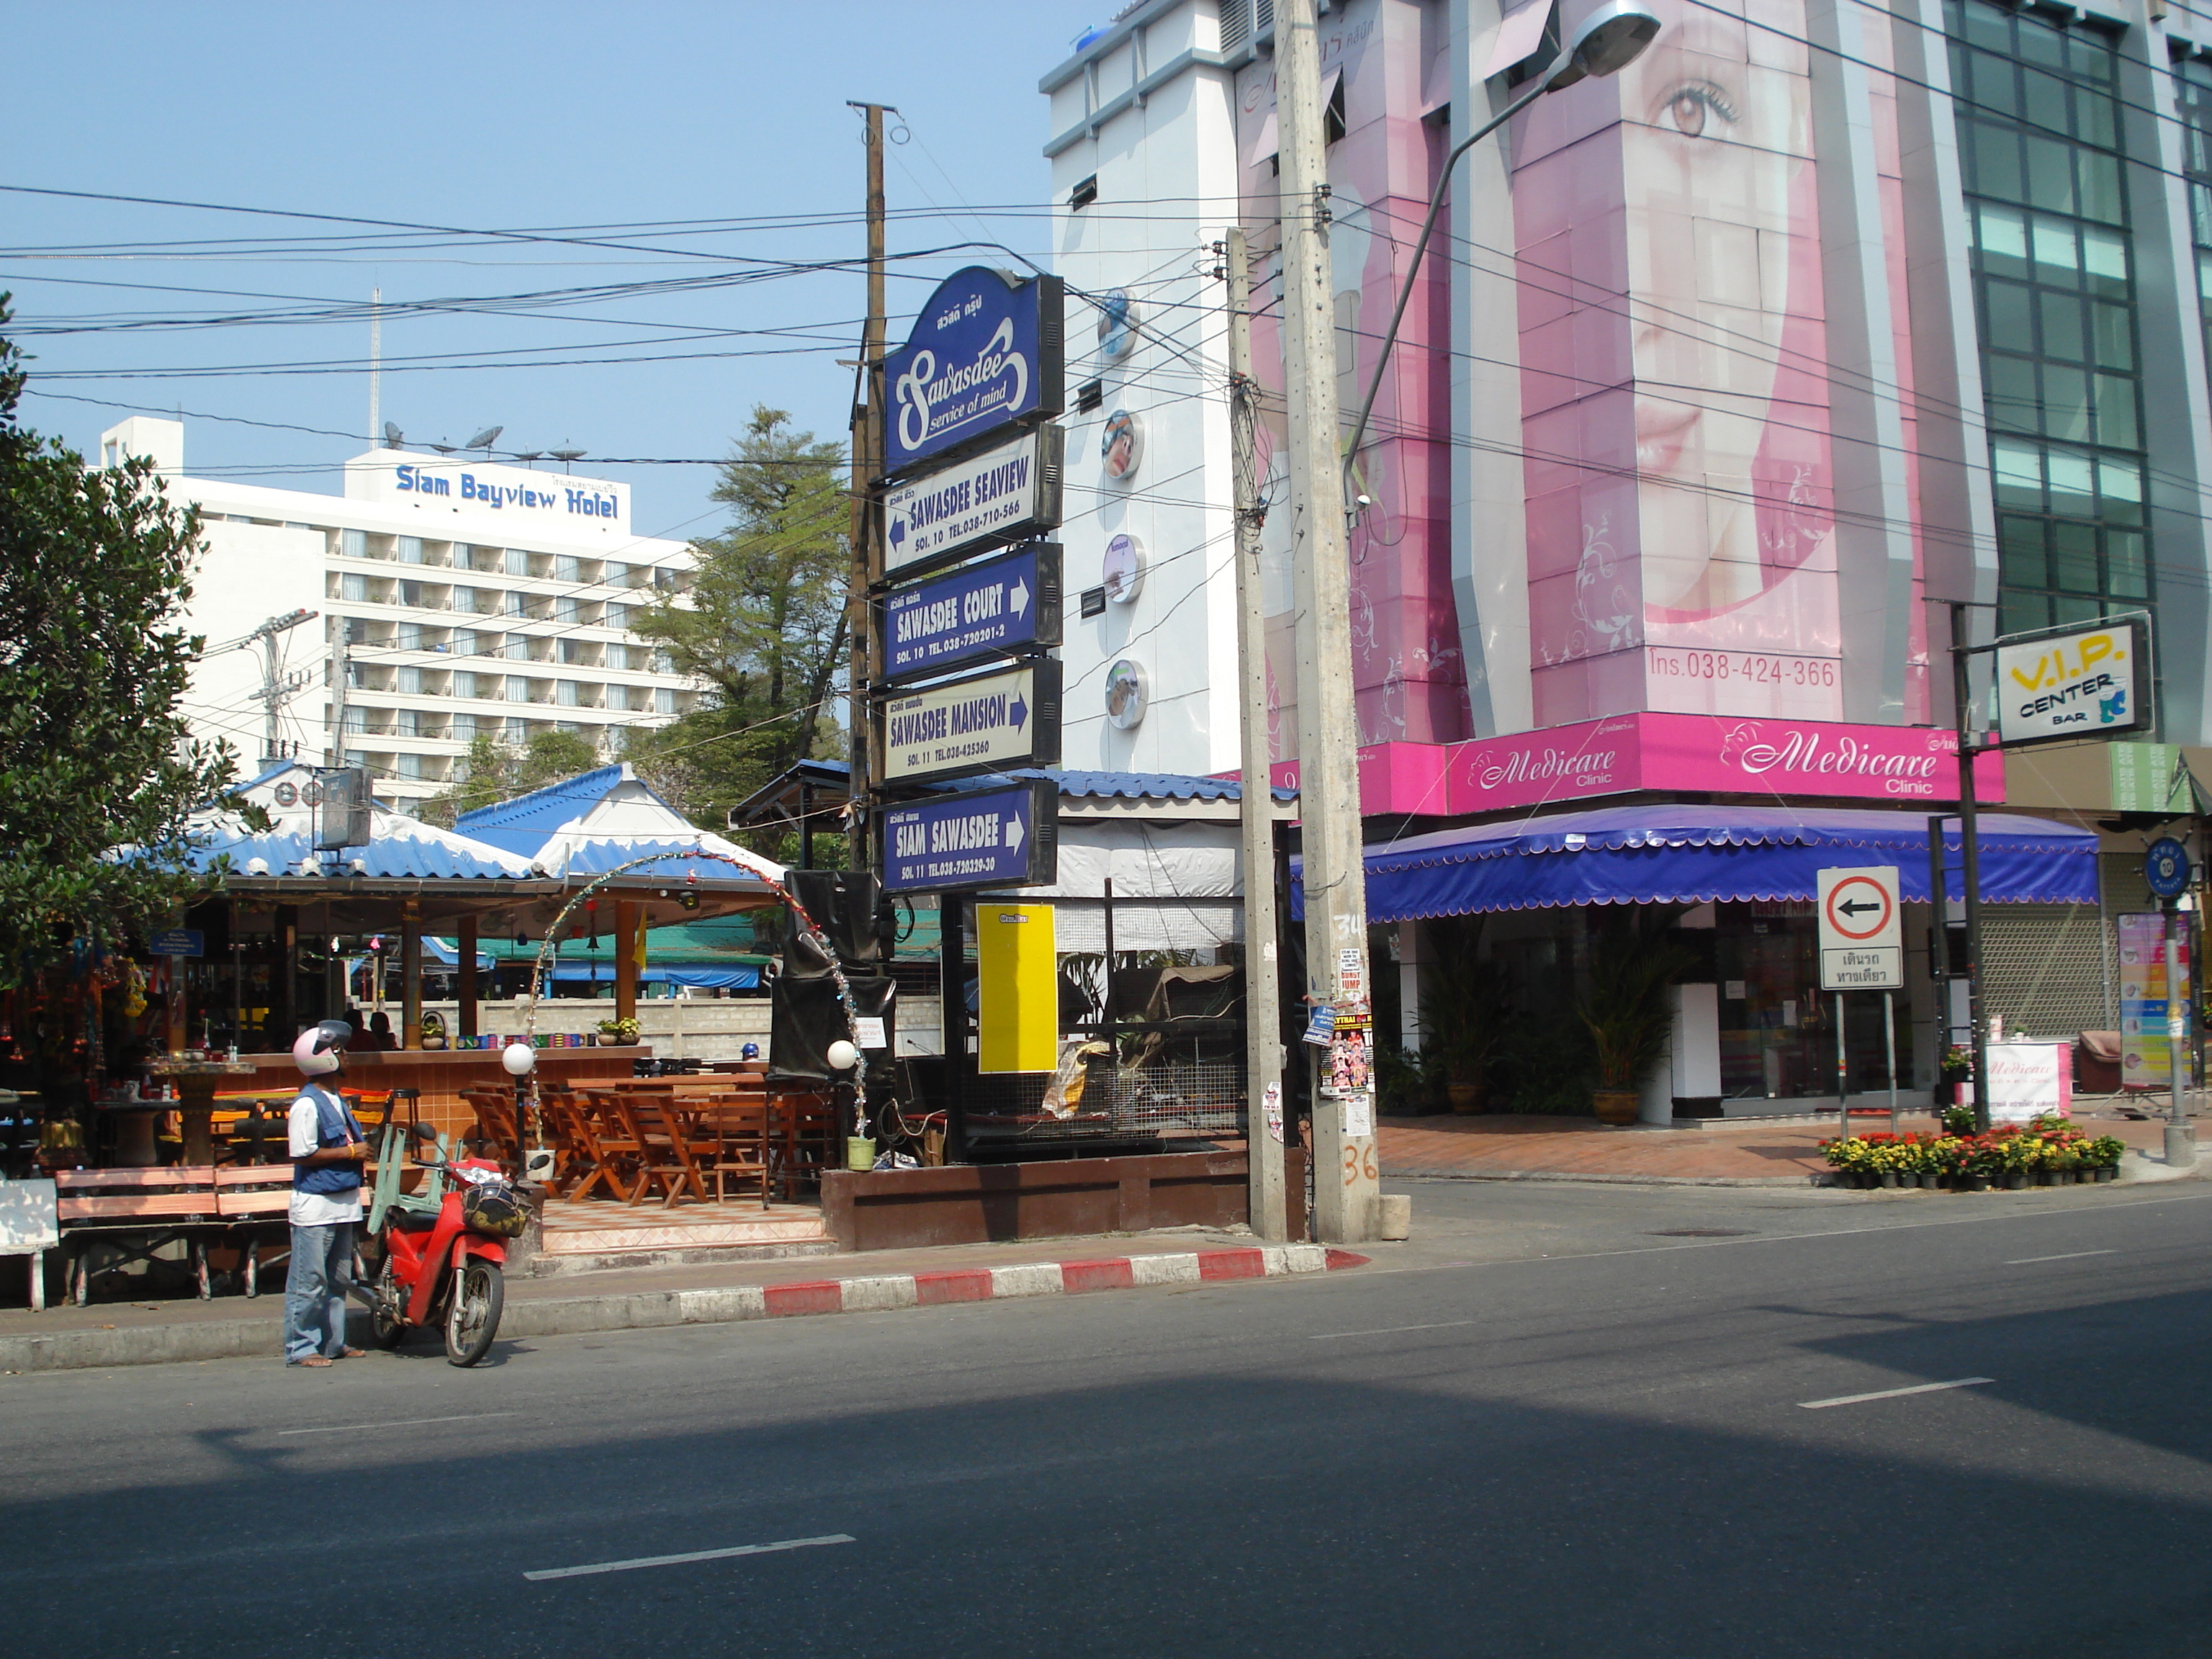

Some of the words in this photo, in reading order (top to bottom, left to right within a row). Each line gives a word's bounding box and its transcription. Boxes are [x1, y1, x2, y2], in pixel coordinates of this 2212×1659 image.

[937, 303, 961, 331] สวัสดี
[896, 317, 1028, 451] Sawasdee
[929, 403, 965, 431] service
[966, 392, 979, 415] of
[981, 379, 1007, 407] mind
[397, 465, 450, 496] Siam
[461, 473, 557, 509] Bayview
[565, 487, 618, 519] Hotel
[910, 480, 971, 531] SAWASDEE
[975, 455, 1029, 506] SEAVIEW
[915, 540, 930, 552] SOI.
[934, 531, 943, 545] 10
[897, 597, 958, 643] SAWASDEE
[963, 583, 1003, 624] COURT
[896, 651, 912, 665] SOI.
[914, 646, 924, 660] 10
[2011, 634, 2126, 692] V.I.P.
[2020, 673, 2114, 718] CENTER
[891, 707, 947, 747] SAWASDEE
[950, 693, 1006, 737] MANSION
[2053, 712, 2087, 725] BAR
[907, 753, 920, 767] SOI.
[922, 751, 930, 763] 11
[935, 740, 989, 763] TEL.038-425360
[1741, 730, 1937, 774] Medicare
[1480, 749, 1616, 790] Medicare
[1576, 773, 1613, 787] Clinic
[1885, 778, 1933, 794] Clinic
[896, 823, 926, 858] SIAM
[931, 812, 999, 853] SAWASDEE
[902, 866, 914, 880] SOI.
[916, 864, 924, 878] 11
[2162, 862, 2172, 873] 10
[1334, 914, 1362, 940] 34
[1837, 968, 1887, 983] ทางเดียว
[1843, 953, 1879, 966] เดินรถ
[1344, 1144, 1378, 1187] 36
